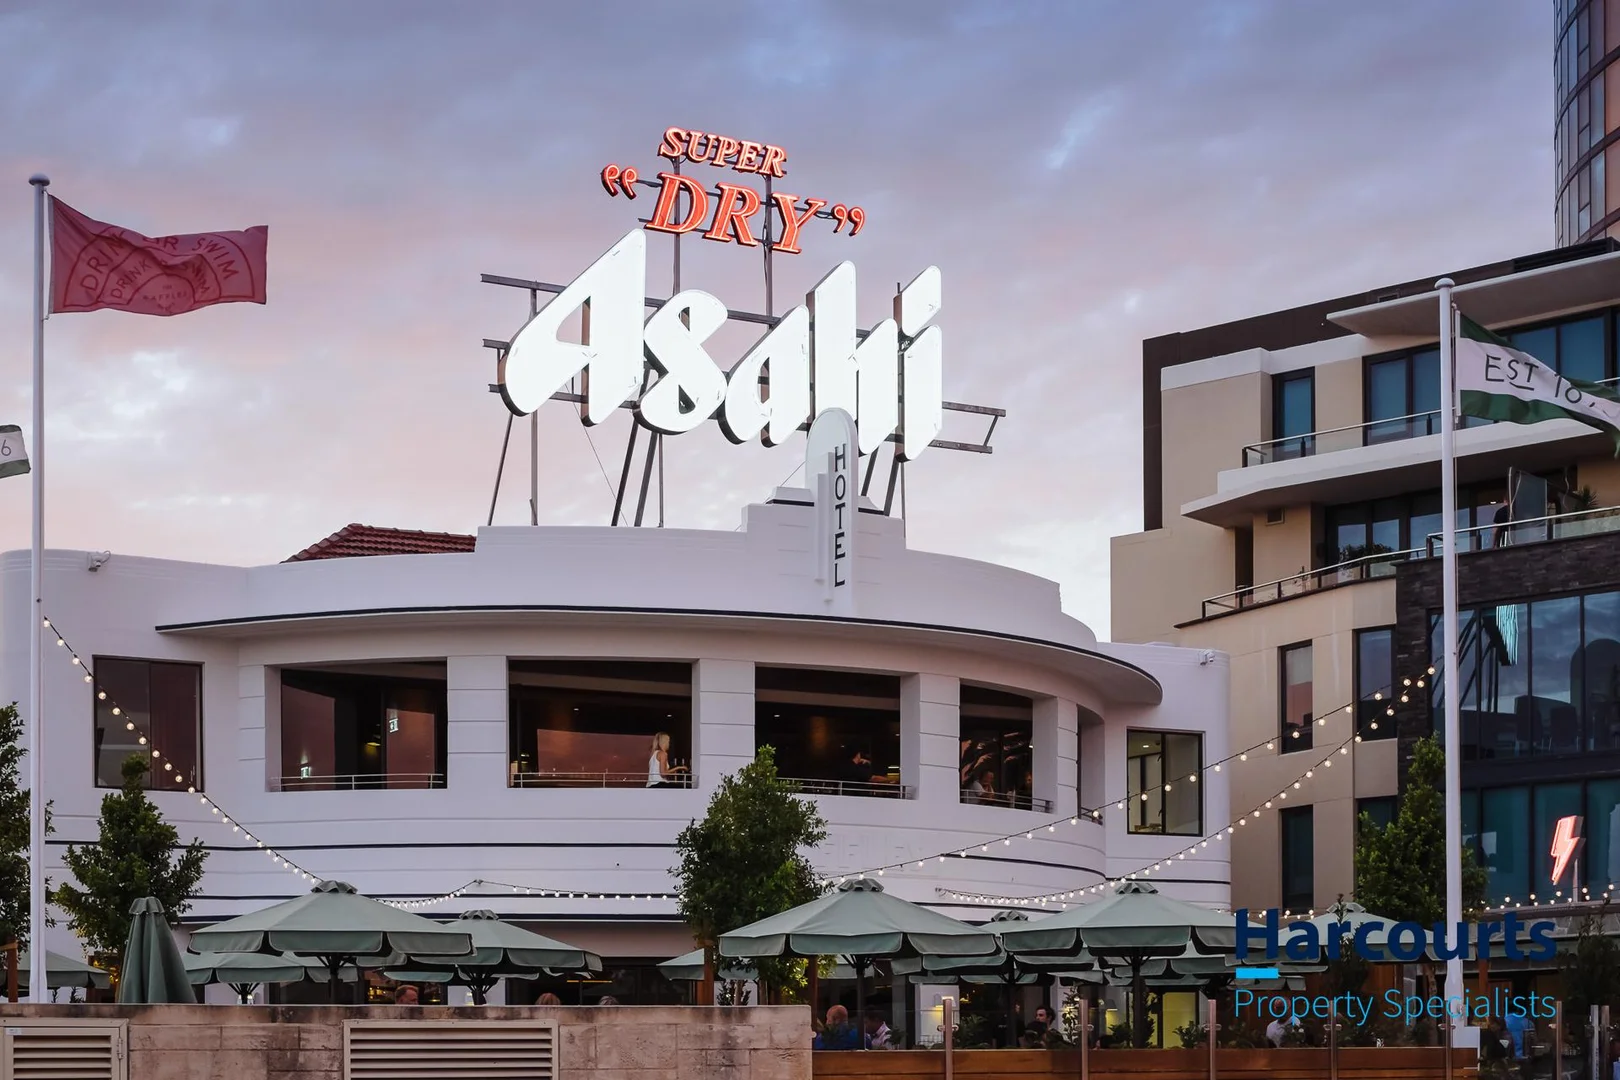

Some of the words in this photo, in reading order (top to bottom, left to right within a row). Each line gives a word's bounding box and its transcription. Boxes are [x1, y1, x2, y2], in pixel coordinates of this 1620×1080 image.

[658, 126, 788, 178] SUPER
[110, 259, 152, 298] DRINK
[192, 237, 239, 280] SWIM
[497, 228, 943, 463] Asahi
[1485, 353, 1540, 384] EST
[834, 443, 847, 588] HOTEL
